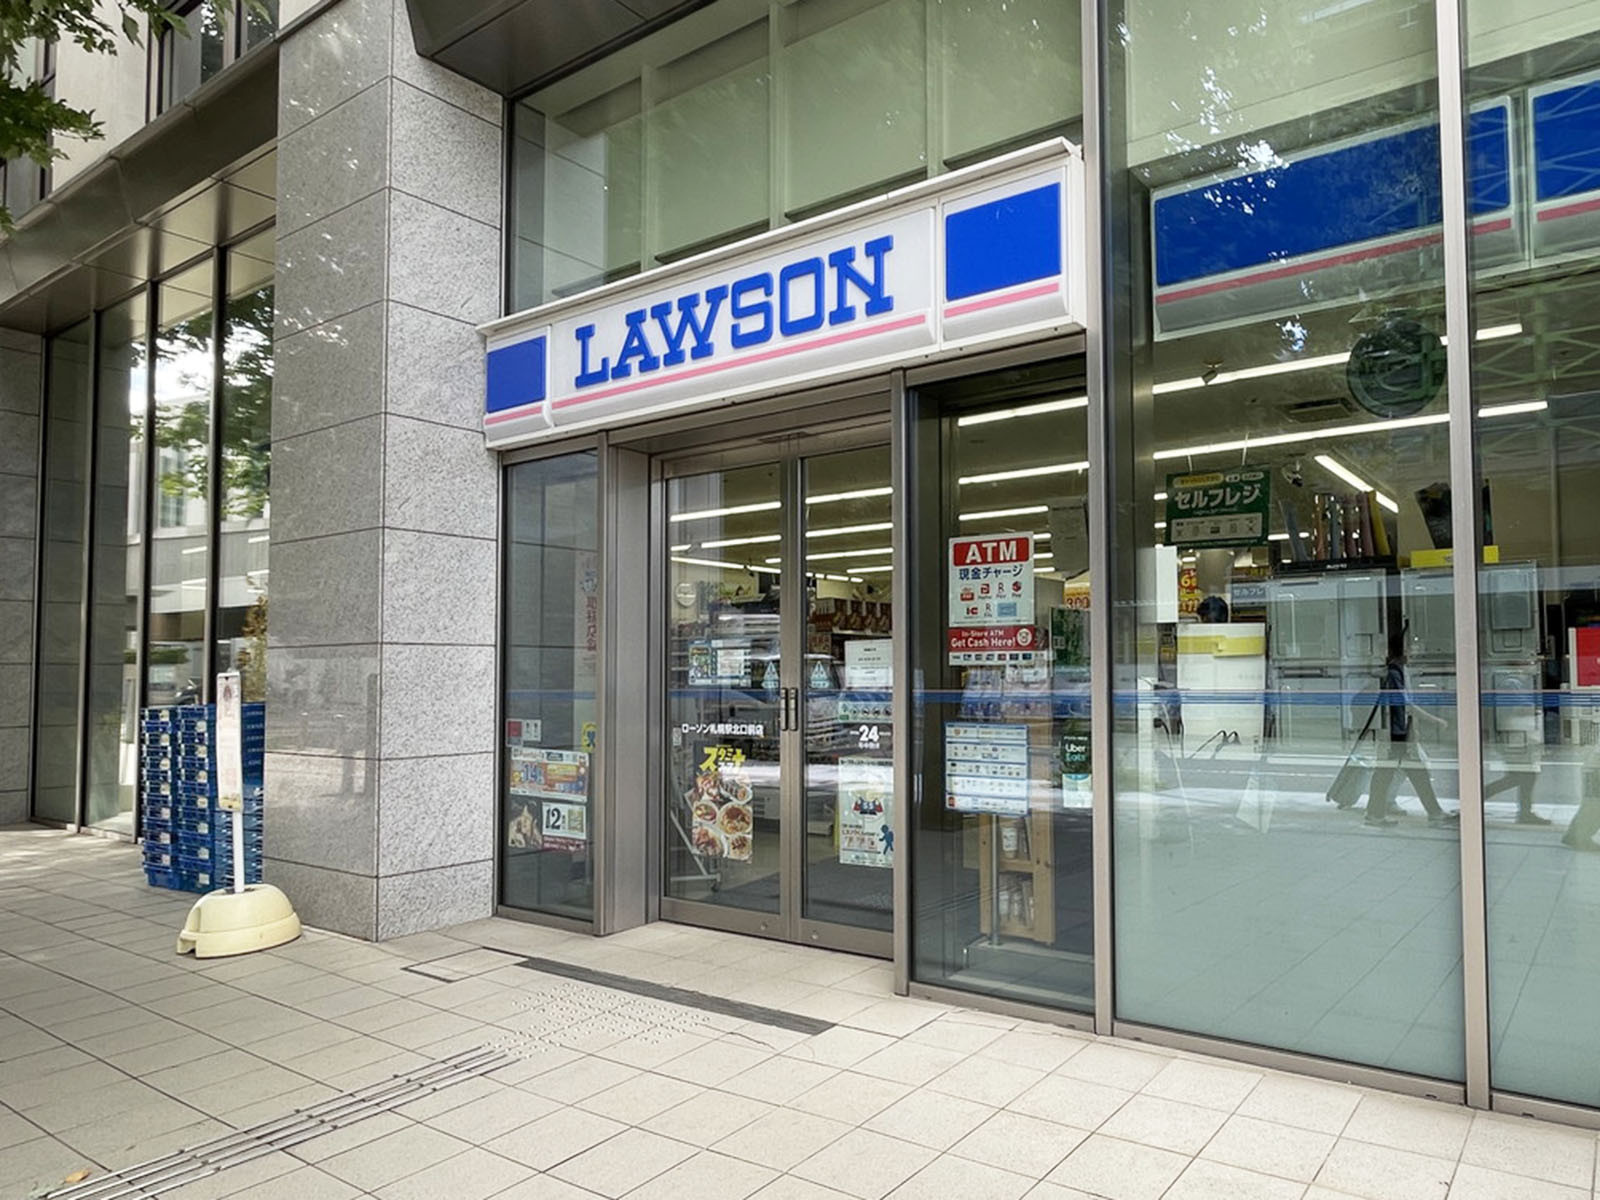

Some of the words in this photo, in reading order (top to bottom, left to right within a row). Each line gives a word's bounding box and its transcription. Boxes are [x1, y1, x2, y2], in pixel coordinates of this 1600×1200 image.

[574, 235, 894, 388] LAWSON
[1174, 484, 1261, 509] セルフレジ
[966, 541, 1017, 564] ATM
[958, 565, 1023, 581] 現金チャージ
[990, 628, 1004, 636] ATM
[951, 638, 967, 648] Get
[967, 638, 989, 647] Cash
[991, 636, 1016, 647] Here!
[859, 724, 880, 742] 24
[1065, 743, 1086, 753] Uber
[545, 807, 561, 830] 12
